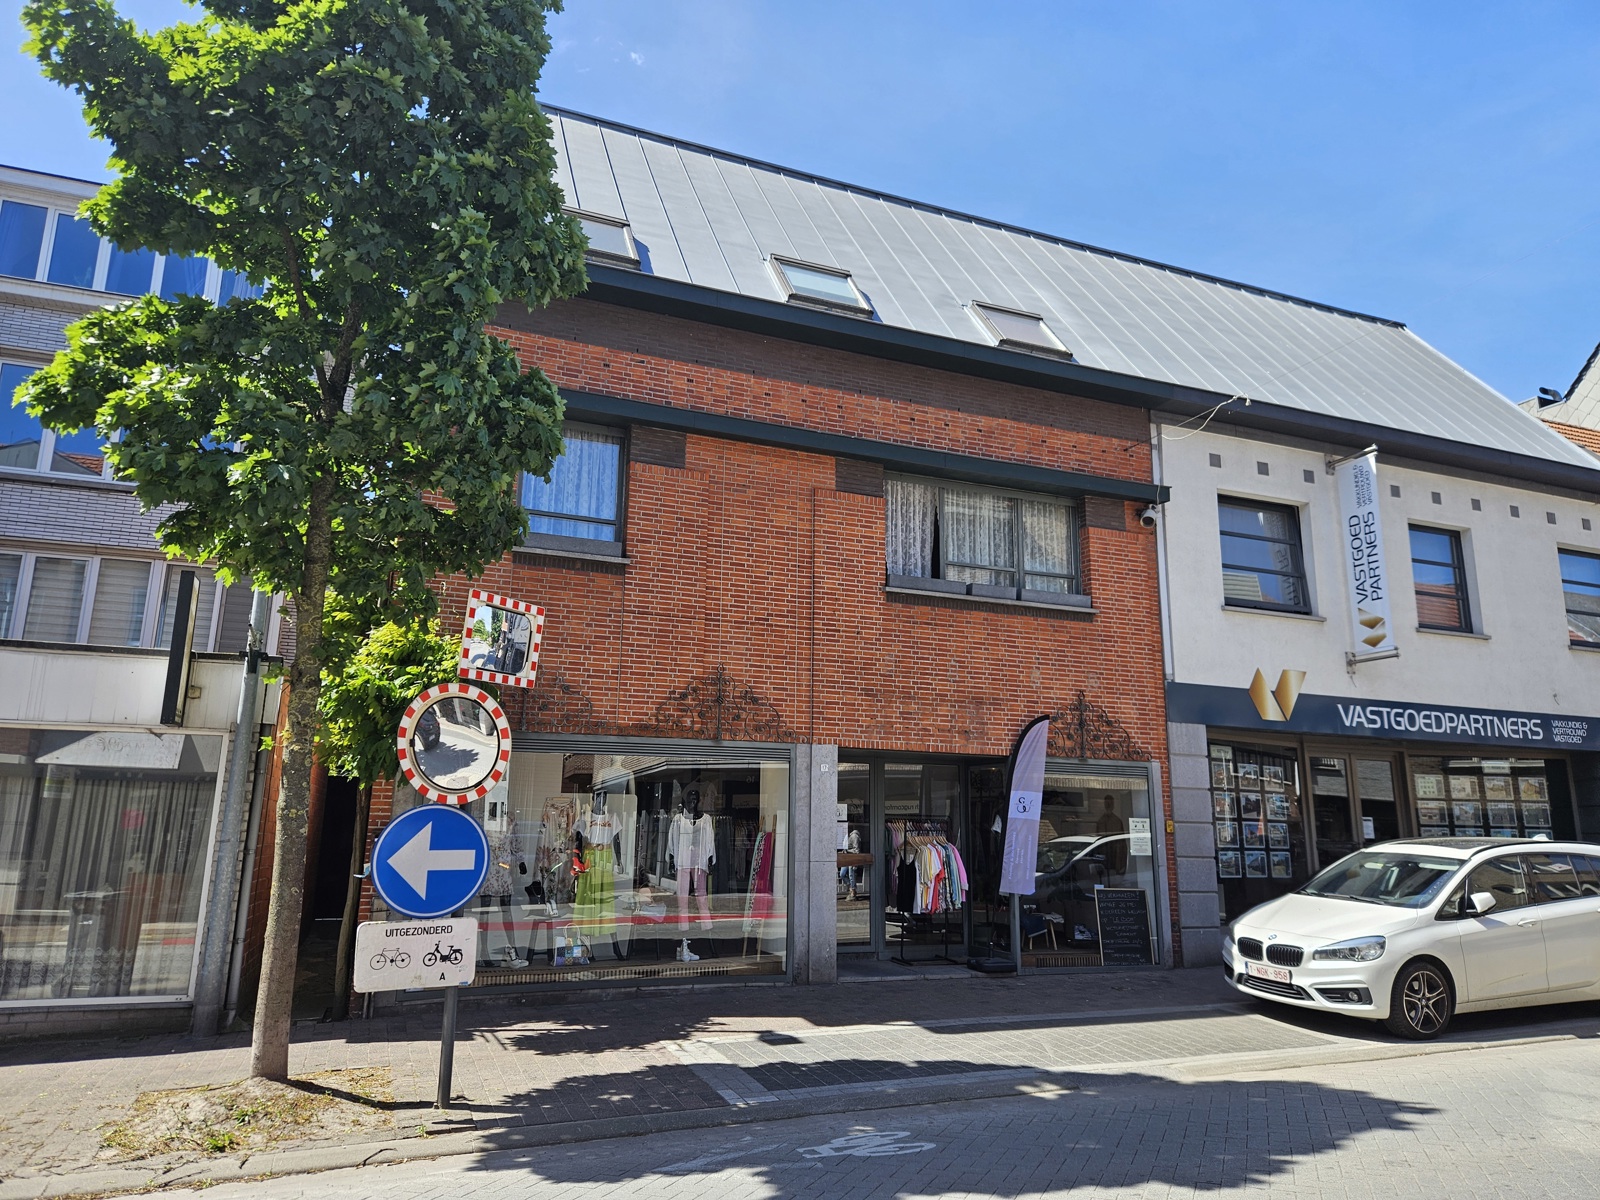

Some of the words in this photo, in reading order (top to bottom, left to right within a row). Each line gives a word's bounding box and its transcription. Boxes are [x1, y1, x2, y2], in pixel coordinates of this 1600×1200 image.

[1348, 514, 1368, 604] VASTGOED
[1362, 511, 1383, 601] PARTNERS
[1336, 703, 1544, 740] VASTGOEDPARTNERS
[1551, 720, 1581, 729] VAKKUNDIG
[1582, 721, 1588, 729] &
[1552, 727, 1587, 737] VERTROUWD
[1553, 734, 1582, 744] VASTGOED
[385, 925, 453, 938] UITGEZONDERD
[439, 972, 446, 981] A
